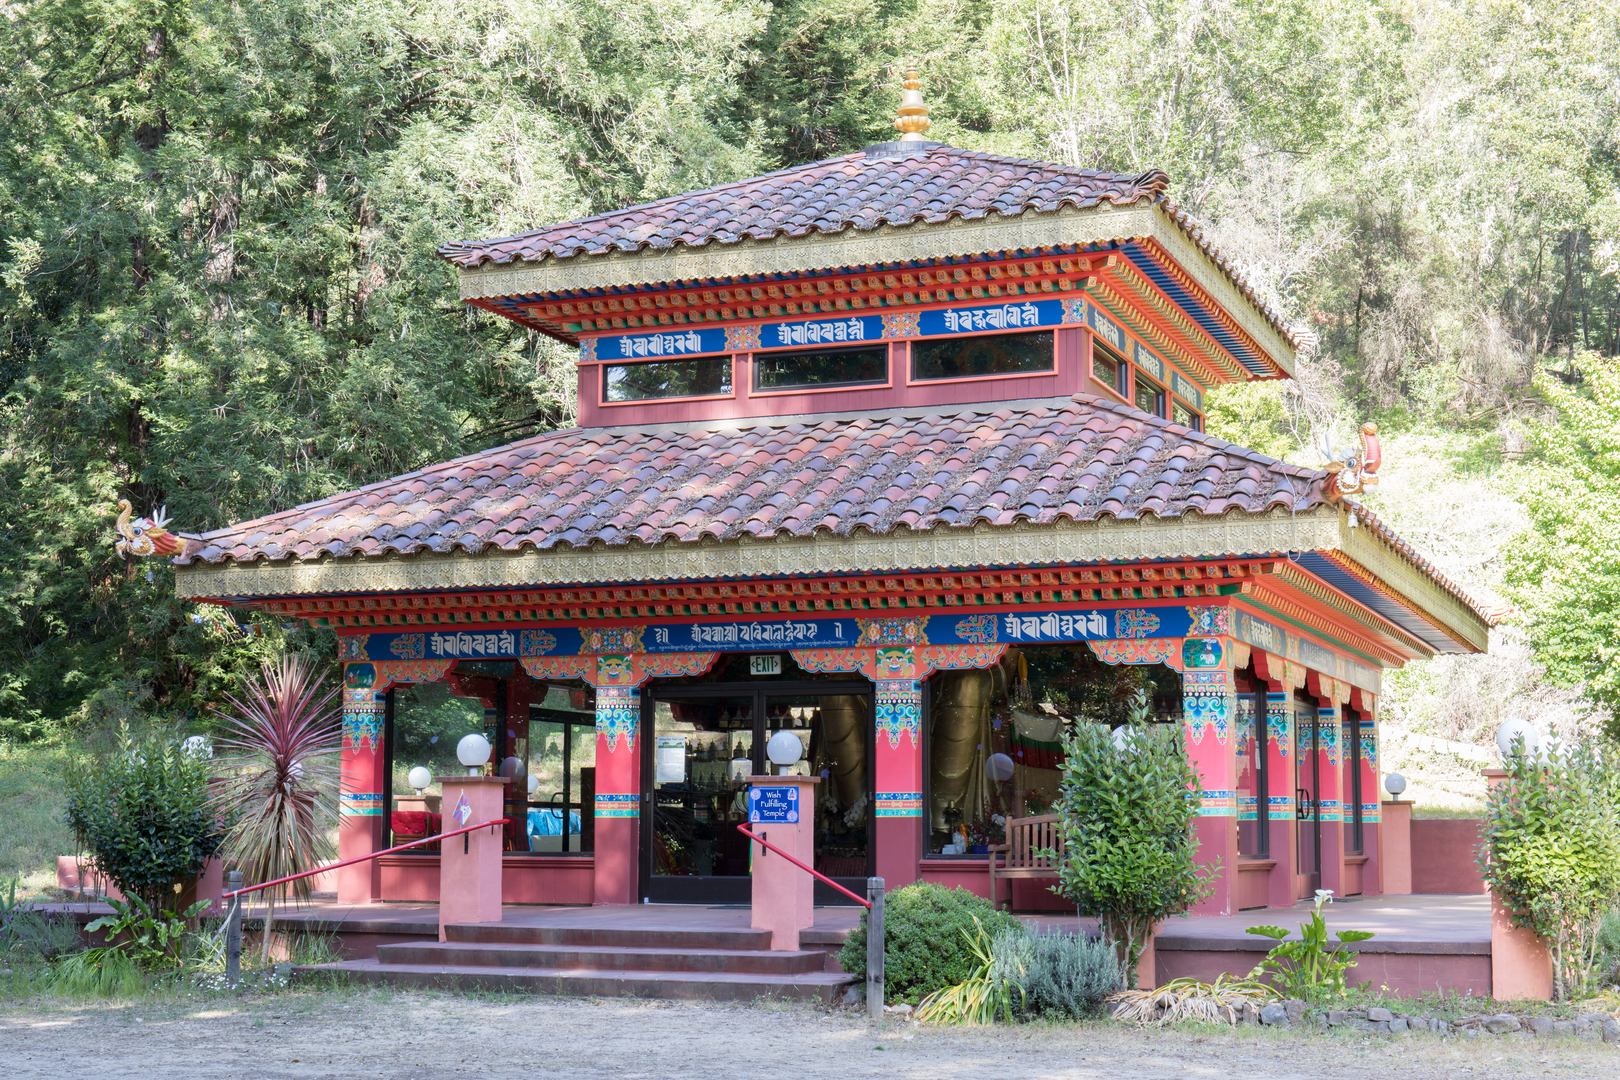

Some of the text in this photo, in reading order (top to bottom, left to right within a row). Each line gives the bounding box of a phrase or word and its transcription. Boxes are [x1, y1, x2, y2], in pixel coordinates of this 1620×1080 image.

[755, 656, 775, 672] EXIT
[766, 790, 781, 798] Wish
[761, 799, 787, 810] Fulfilling
[763, 808, 784, 820] Temple
